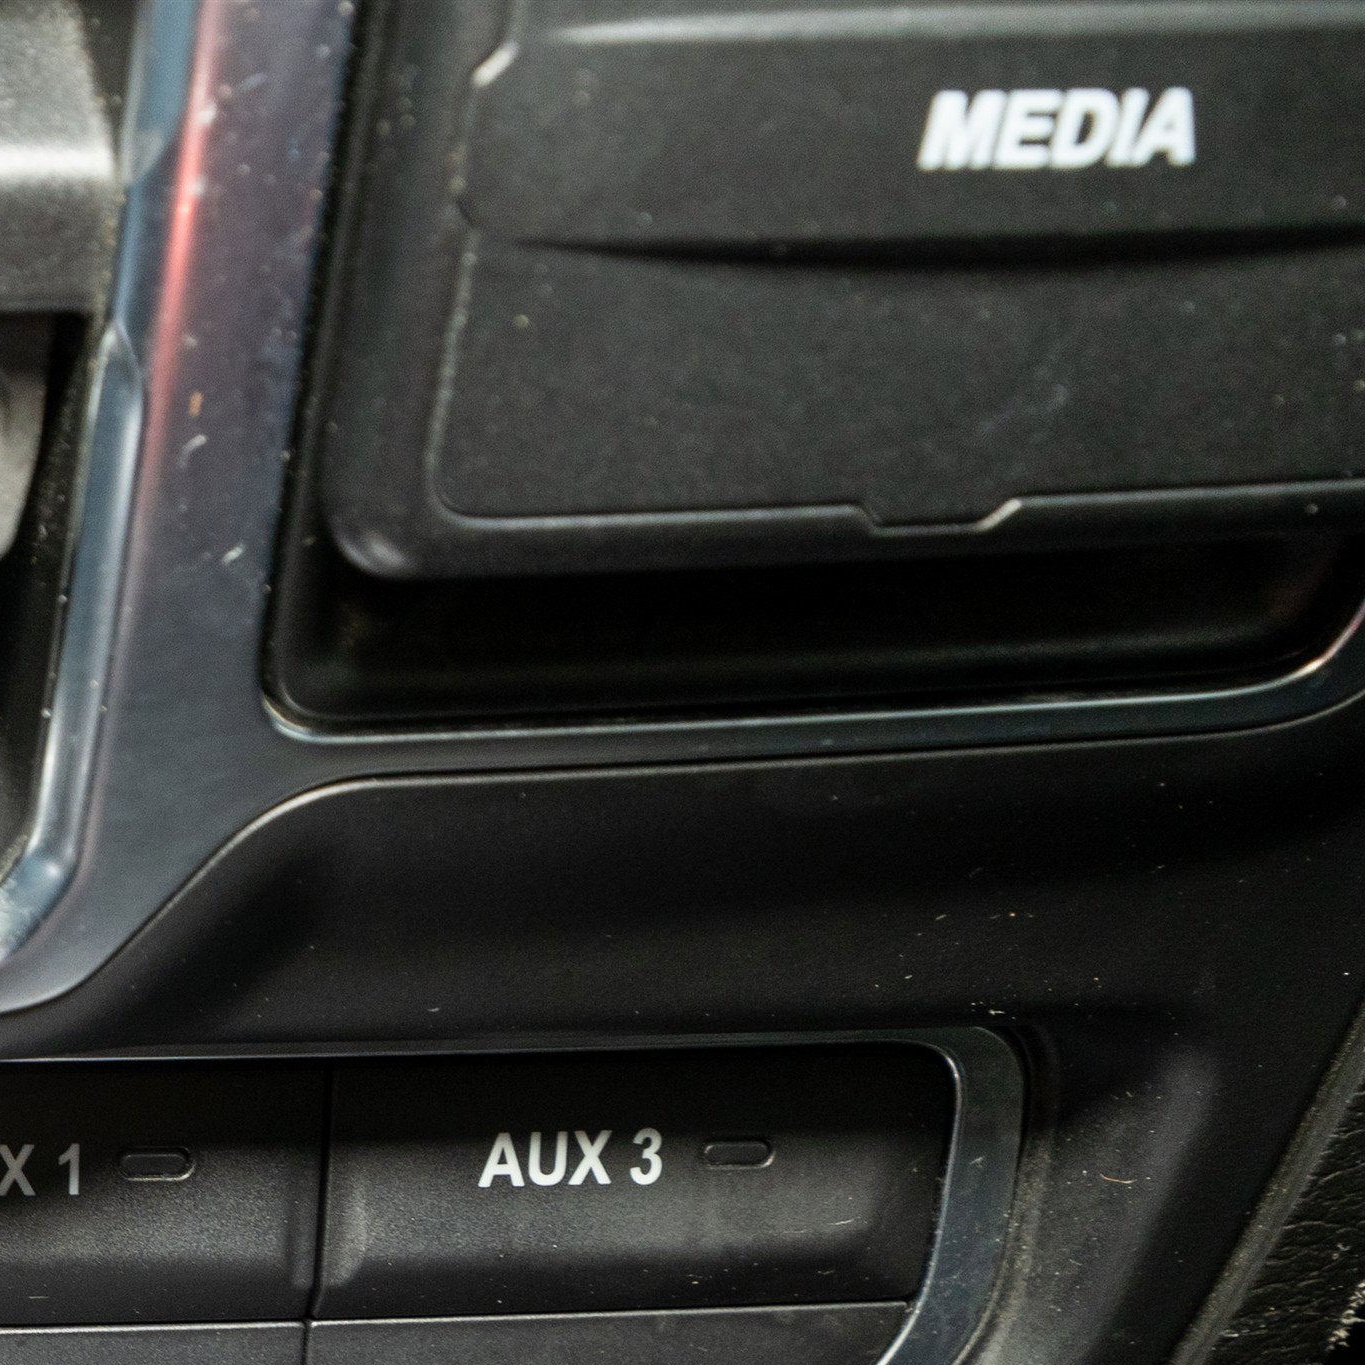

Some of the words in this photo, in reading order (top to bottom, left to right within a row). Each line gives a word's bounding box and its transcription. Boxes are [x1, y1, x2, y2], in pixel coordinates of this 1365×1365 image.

[917, 86, 1196, 170] MEDIA
[58, 1143, 82, 1196] 1
[478, 1129, 613, 1188] AUX
[629, 1127, 663, 1185] 3
